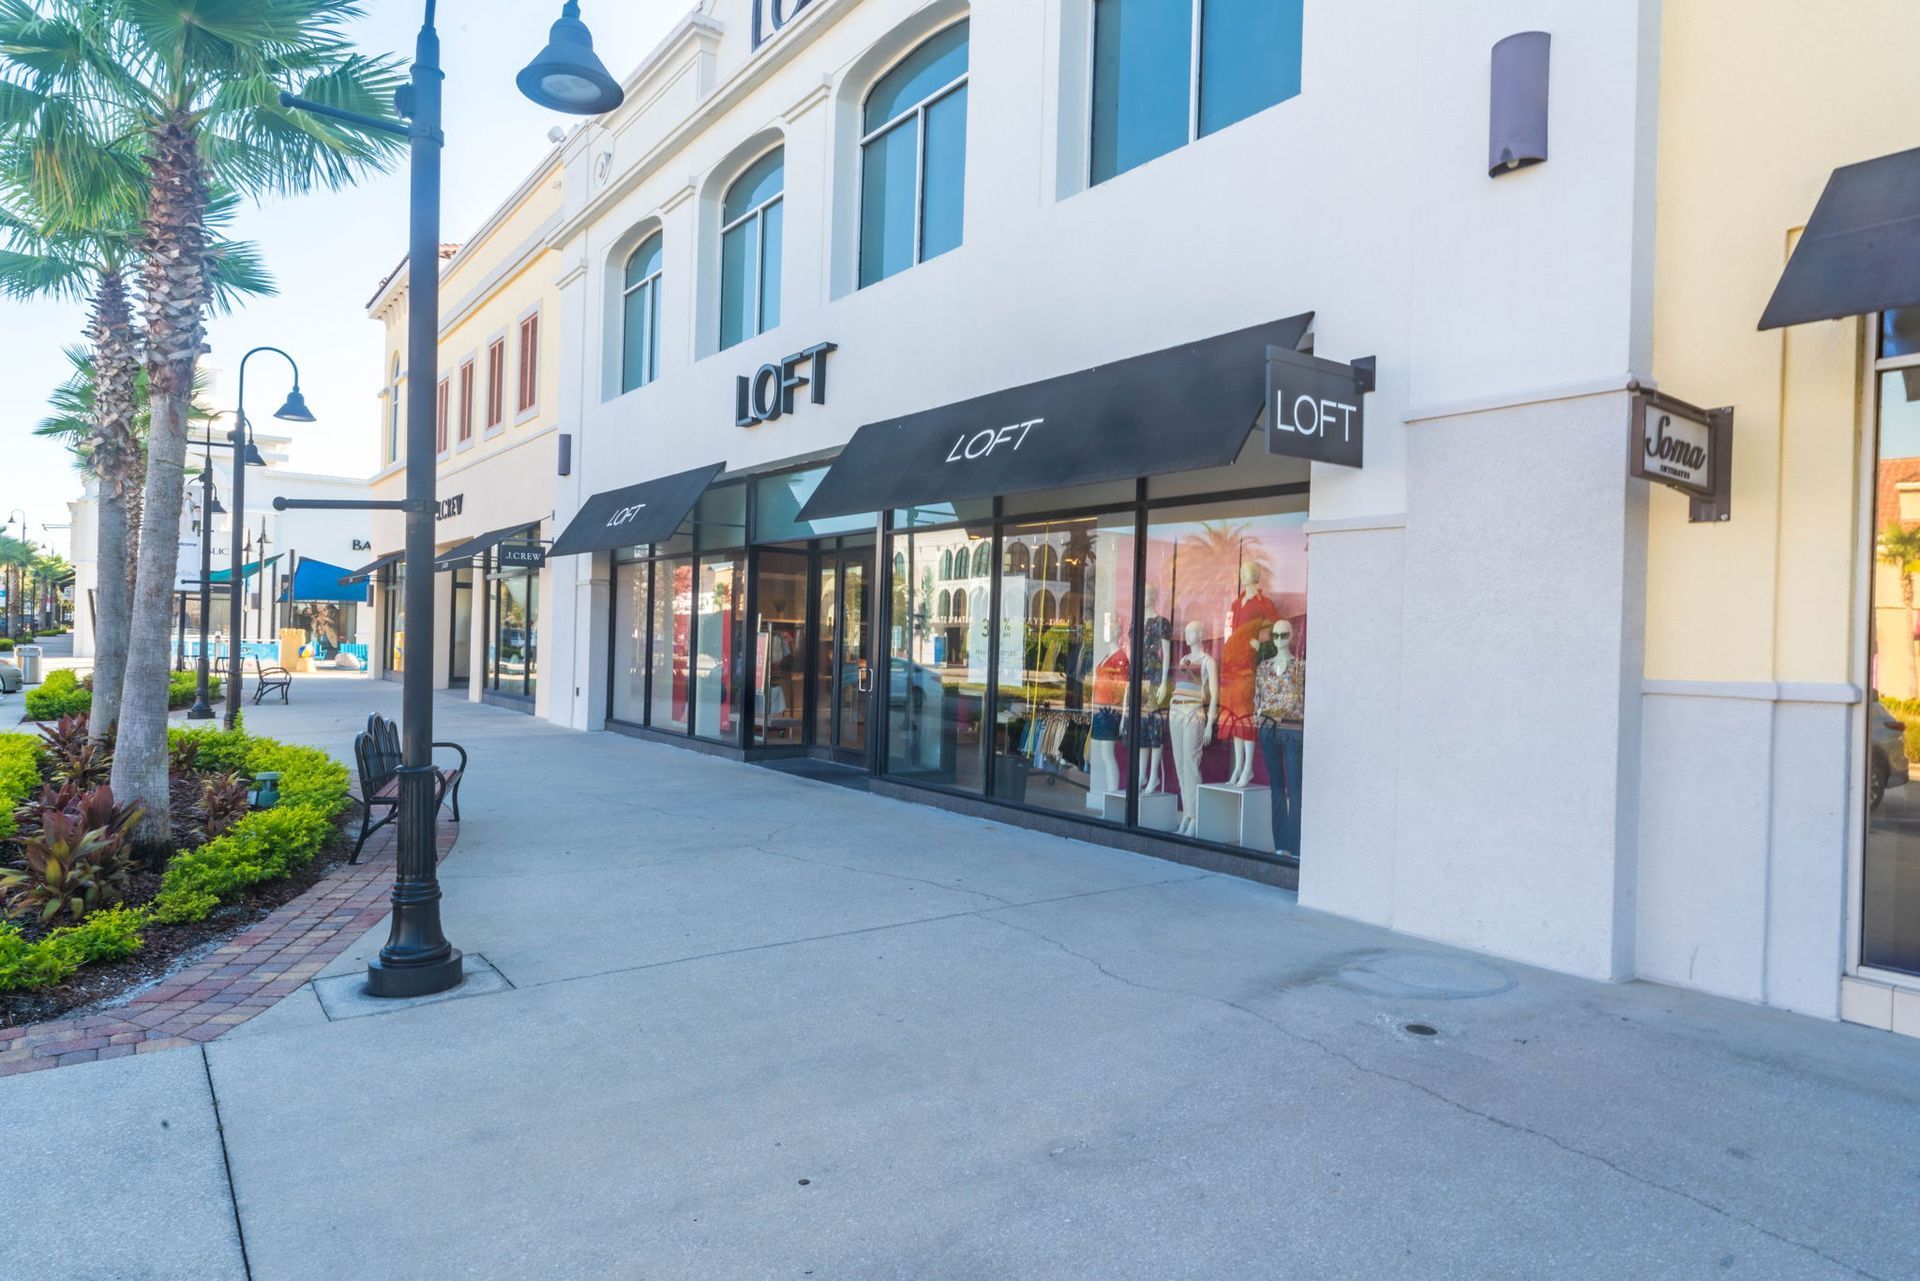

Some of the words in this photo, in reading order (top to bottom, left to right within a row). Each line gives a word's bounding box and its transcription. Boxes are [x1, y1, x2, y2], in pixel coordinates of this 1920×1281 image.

[735, 341, 838, 428] LOFT
[945, 417, 1045, 463] LOFT
[1277, 389, 1357, 442] LOFT
[1645, 415, 1706, 471] Soma
[606, 503, 646, 528] LOFT
[505, 551, 542, 562] J.CREW
